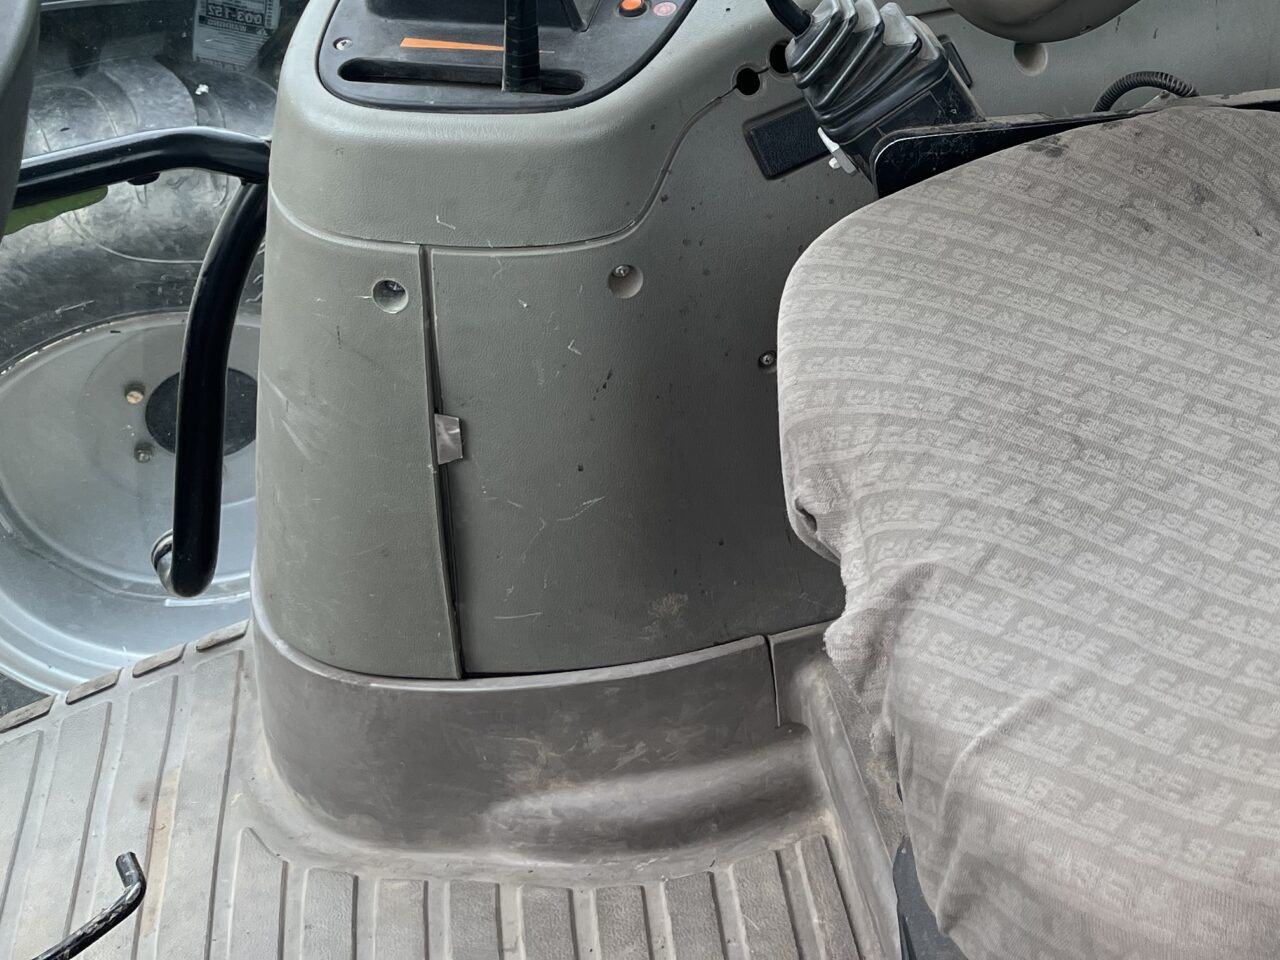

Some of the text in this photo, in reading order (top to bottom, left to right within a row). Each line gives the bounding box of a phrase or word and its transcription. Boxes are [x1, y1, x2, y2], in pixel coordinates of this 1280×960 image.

[1169, 147, 1236, 191] CASE
[1062, 195, 1134, 237] CASE
[953, 247, 1028, 279] CASE
[1025, 242, 1101, 275] CASE
[1102, 244, 1177, 284] CASE
[917, 289, 995, 317] CASE
[990, 286, 1068, 317] CASE
[1065, 281, 1143, 317] CASE
[878, 329, 954, 356] CASE
[954, 323, 1034, 359] CASE
[1029, 322, 1109, 356] CASE
[1106, 322, 1184, 356] CASE
[1178, 322, 1258, 356] CASE
[918, 365, 1000, 398] CASE
[997, 362, 1079, 398] CASE
[1073, 362, 1153, 397] CASE
[1150, 362, 1230, 397] CASE
[958, 406, 1042, 439] CASE
[1116, 403, 1200, 438] CASE
[1194, 403, 1280, 439] CASE
[918, 465, 1000, 492] CASE
[1001, 448, 1082, 486] CASE
[1082, 448, 1165, 484] CASE
[1159, 448, 1247, 484] CASE
[953, 510, 1039, 540] CASE
[1043, 498, 1123, 537] CASE
[1122, 499, 1208, 537] CASE
[986, 559, 1075, 599] CASE
[1075, 551, 1162, 592] CASE
[1162, 549, 1251, 590] CASE
[1018, 615, 1111, 660] CASE
[1112, 607, 1203, 654] CASE
[929, 632, 1014, 671] CASE
[1150, 669, 1248, 716] CASE
[982, 760, 1085, 815] CASE
[1085, 742, 1192, 800] CASE
[1129, 822, 1246, 875] CASE
[1025, 840, 1132, 909] CASE
